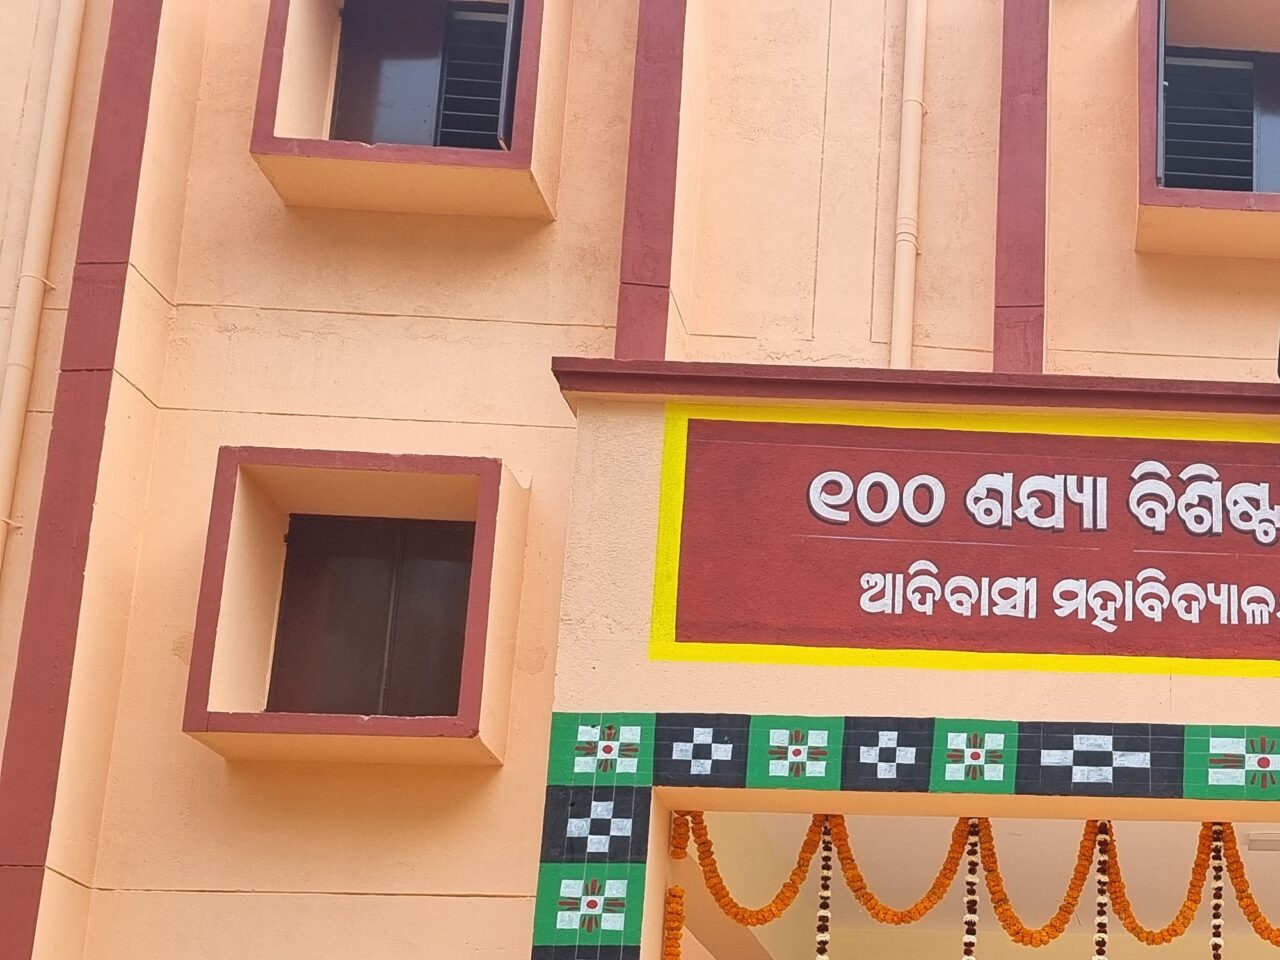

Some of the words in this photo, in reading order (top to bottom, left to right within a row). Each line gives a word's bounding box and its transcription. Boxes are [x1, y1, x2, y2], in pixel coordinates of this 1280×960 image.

[809, 471, 946, 523] ୧୦୦
[965, 472, 1108, 529] ଶଯ୍ୟା
[859, 559, 1037, 619] ଆଦିବାସୀ
